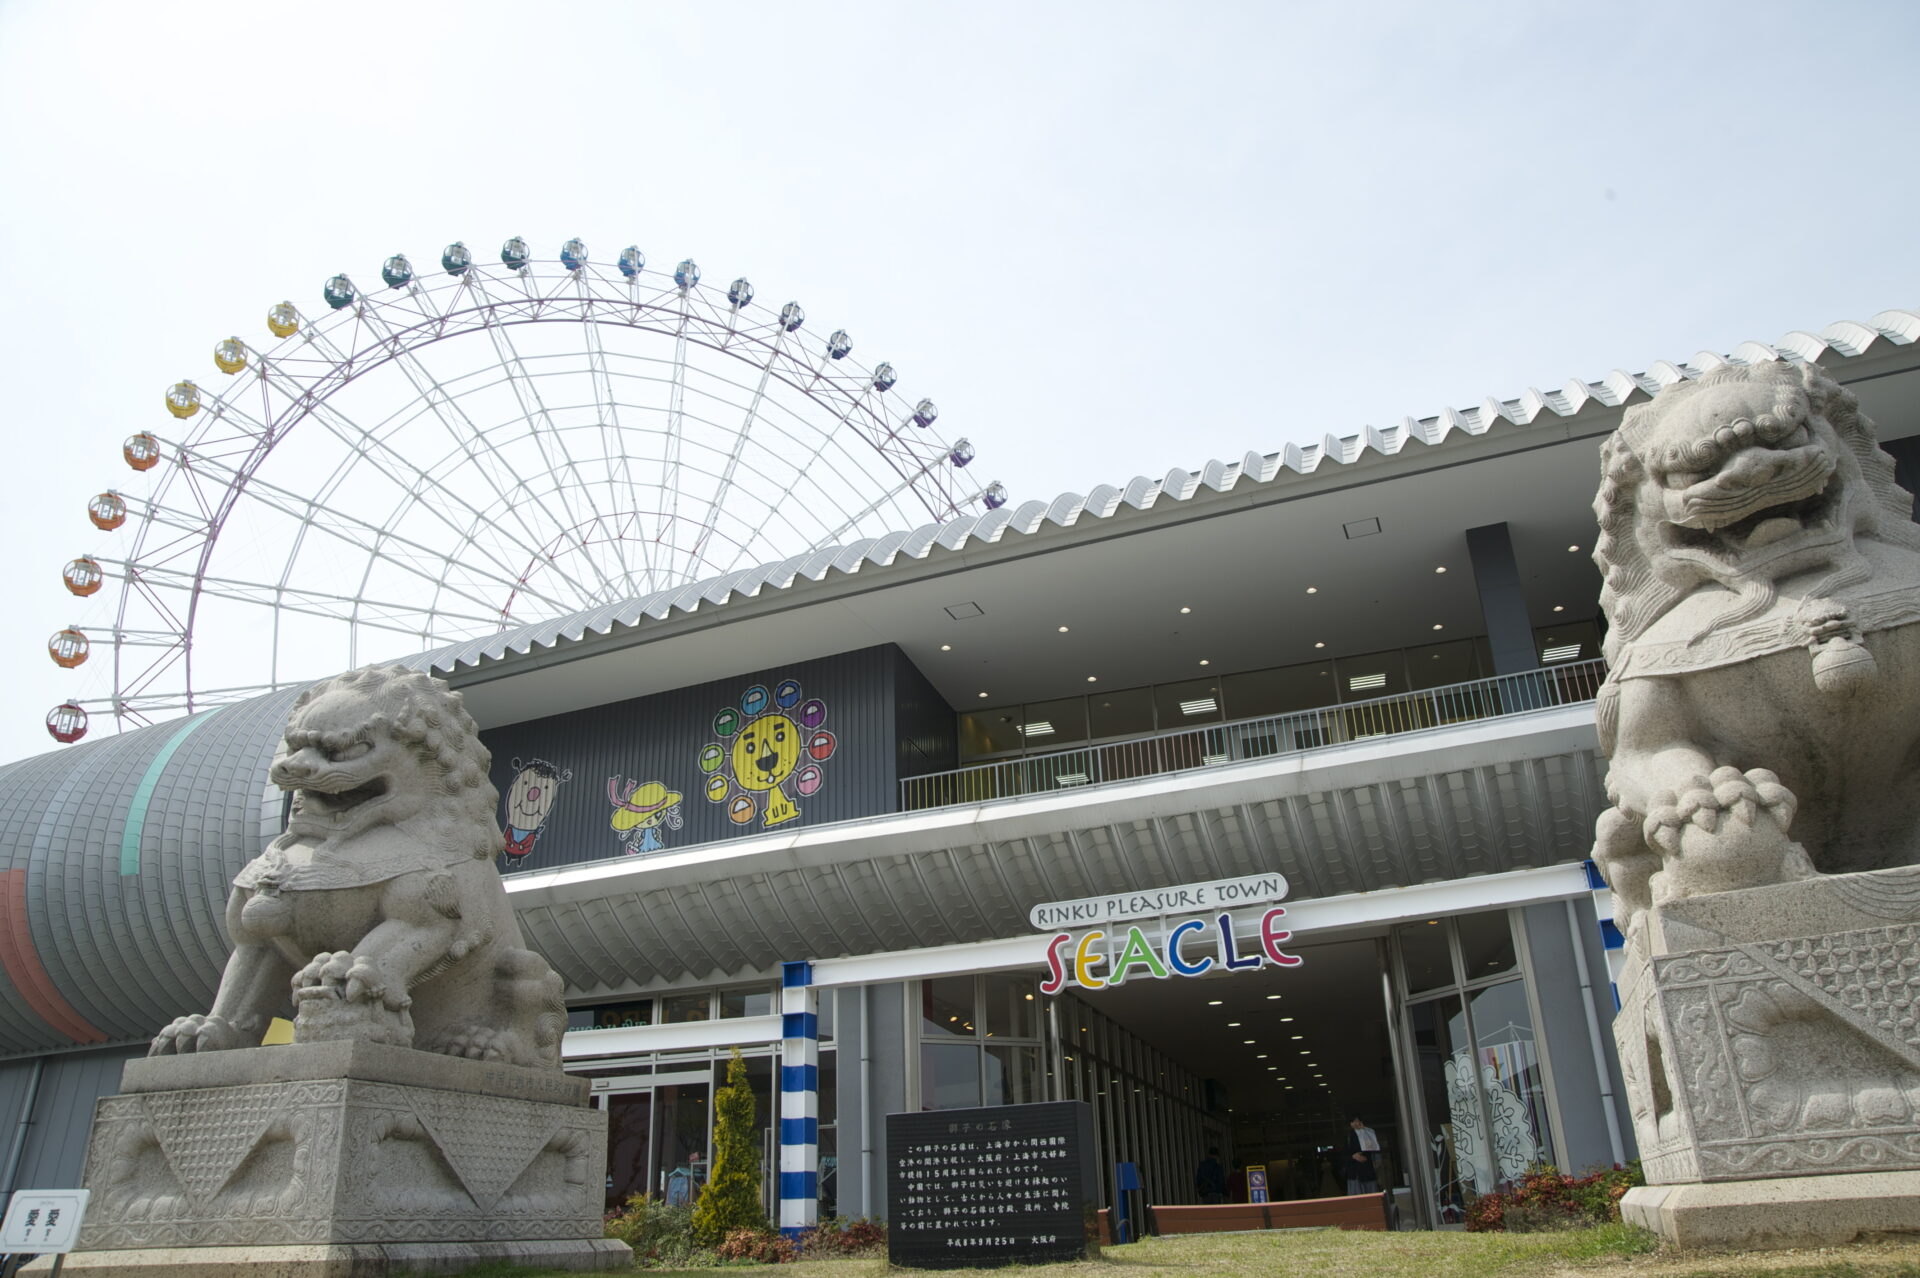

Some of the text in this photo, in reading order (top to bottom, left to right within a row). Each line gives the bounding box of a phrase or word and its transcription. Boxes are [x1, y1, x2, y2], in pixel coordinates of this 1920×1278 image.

[1037, 879, 1279, 925] RINKU PLEASURE TOWN
[1040, 907, 1304, 994] SEACLE
